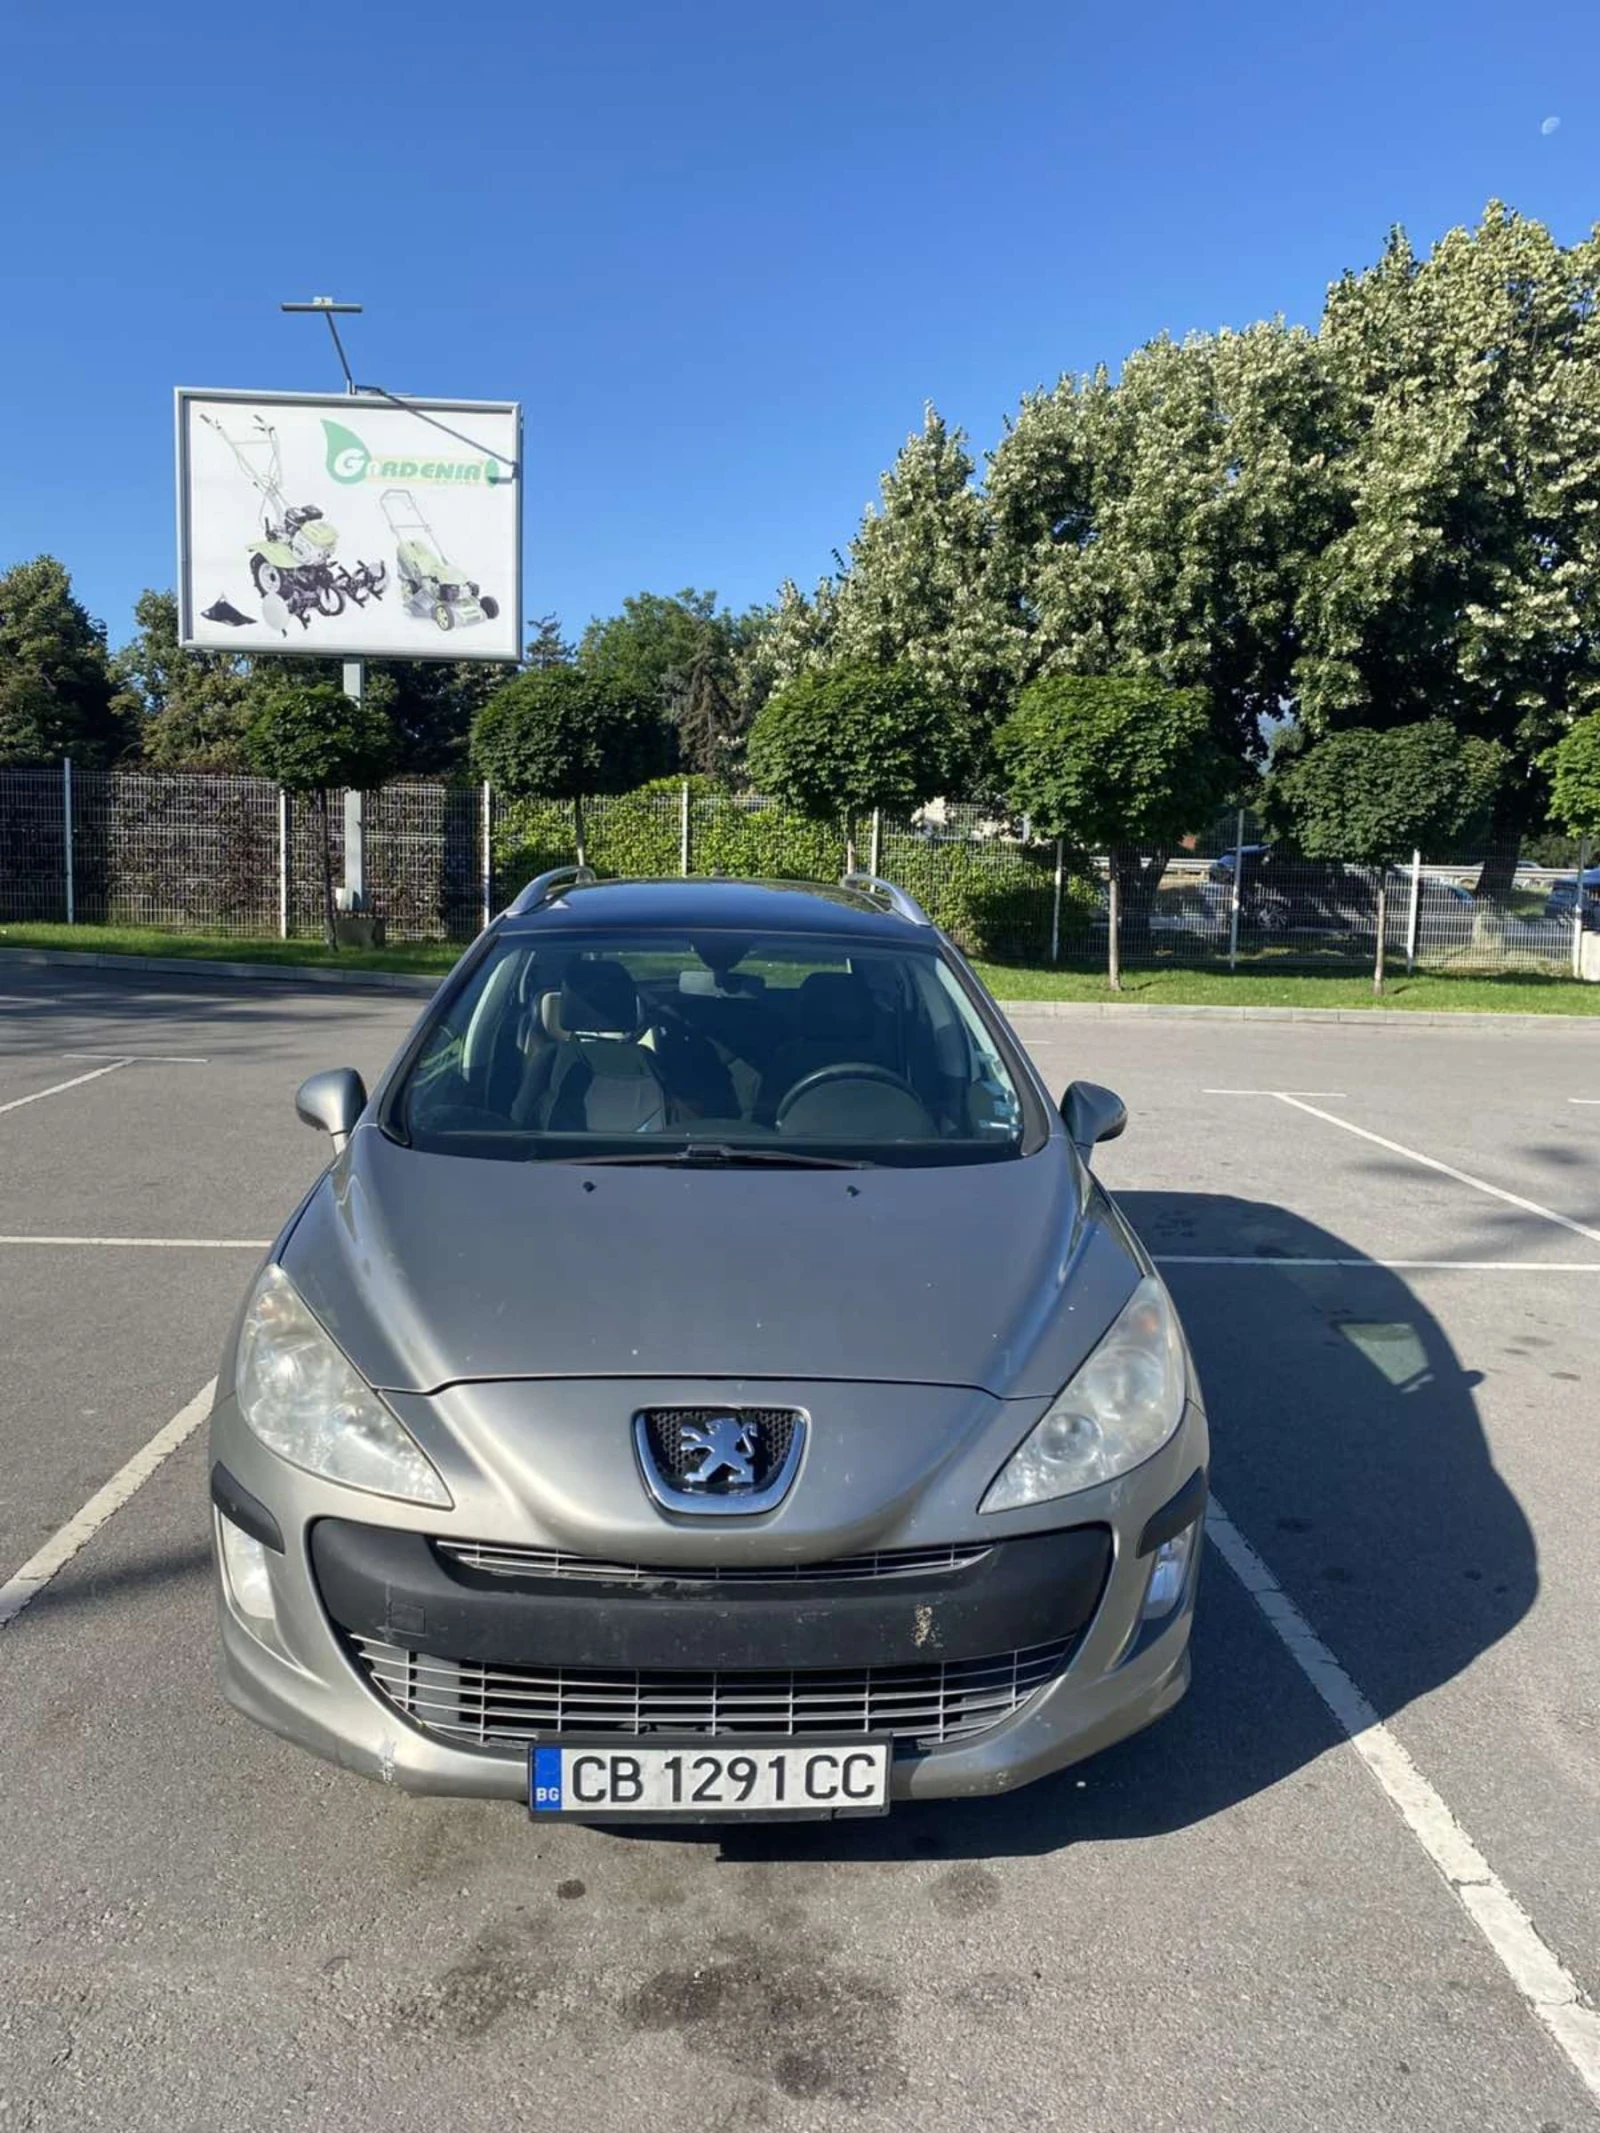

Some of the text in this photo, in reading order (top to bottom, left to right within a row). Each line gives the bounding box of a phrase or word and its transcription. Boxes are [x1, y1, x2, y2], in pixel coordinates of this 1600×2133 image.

[572, 1753, 875, 1802] CB 1291 CC
[536, 1787, 559, 1802] BG
